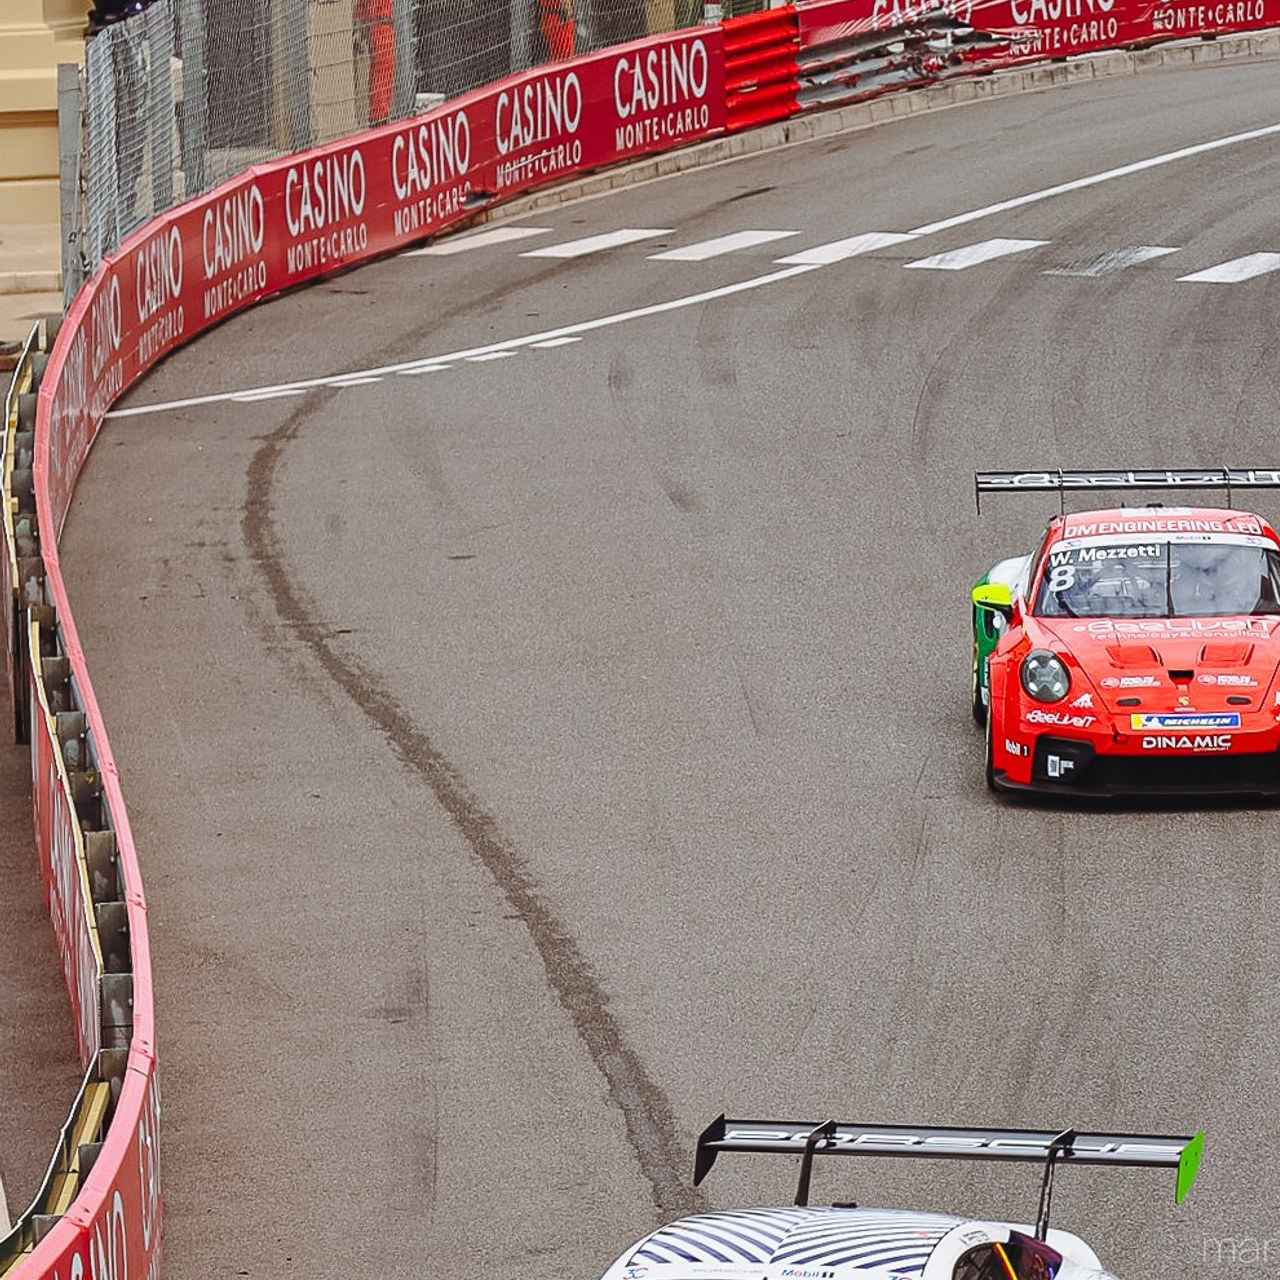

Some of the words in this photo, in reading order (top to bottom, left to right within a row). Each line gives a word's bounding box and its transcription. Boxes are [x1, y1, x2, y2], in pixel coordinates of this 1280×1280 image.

[496, 71, 582, 156] CASINO
[613, 38, 709, 118] CASINO
[285, 148, 367, 238] CASINO
[392, 110, 471, 201] CASINO
[202, 183, 265, 280] CASINO
[136, 225, 183, 324] CASINO
[1048, 565, 1075, 592] 8
[1050, 553, 1075, 569] W.
[1077, 543, 1161, 564] Mezzetti
[1142, 734, 1232, 749] DINAMIC
[1163, 717, 1232, 726] MICHELIN
